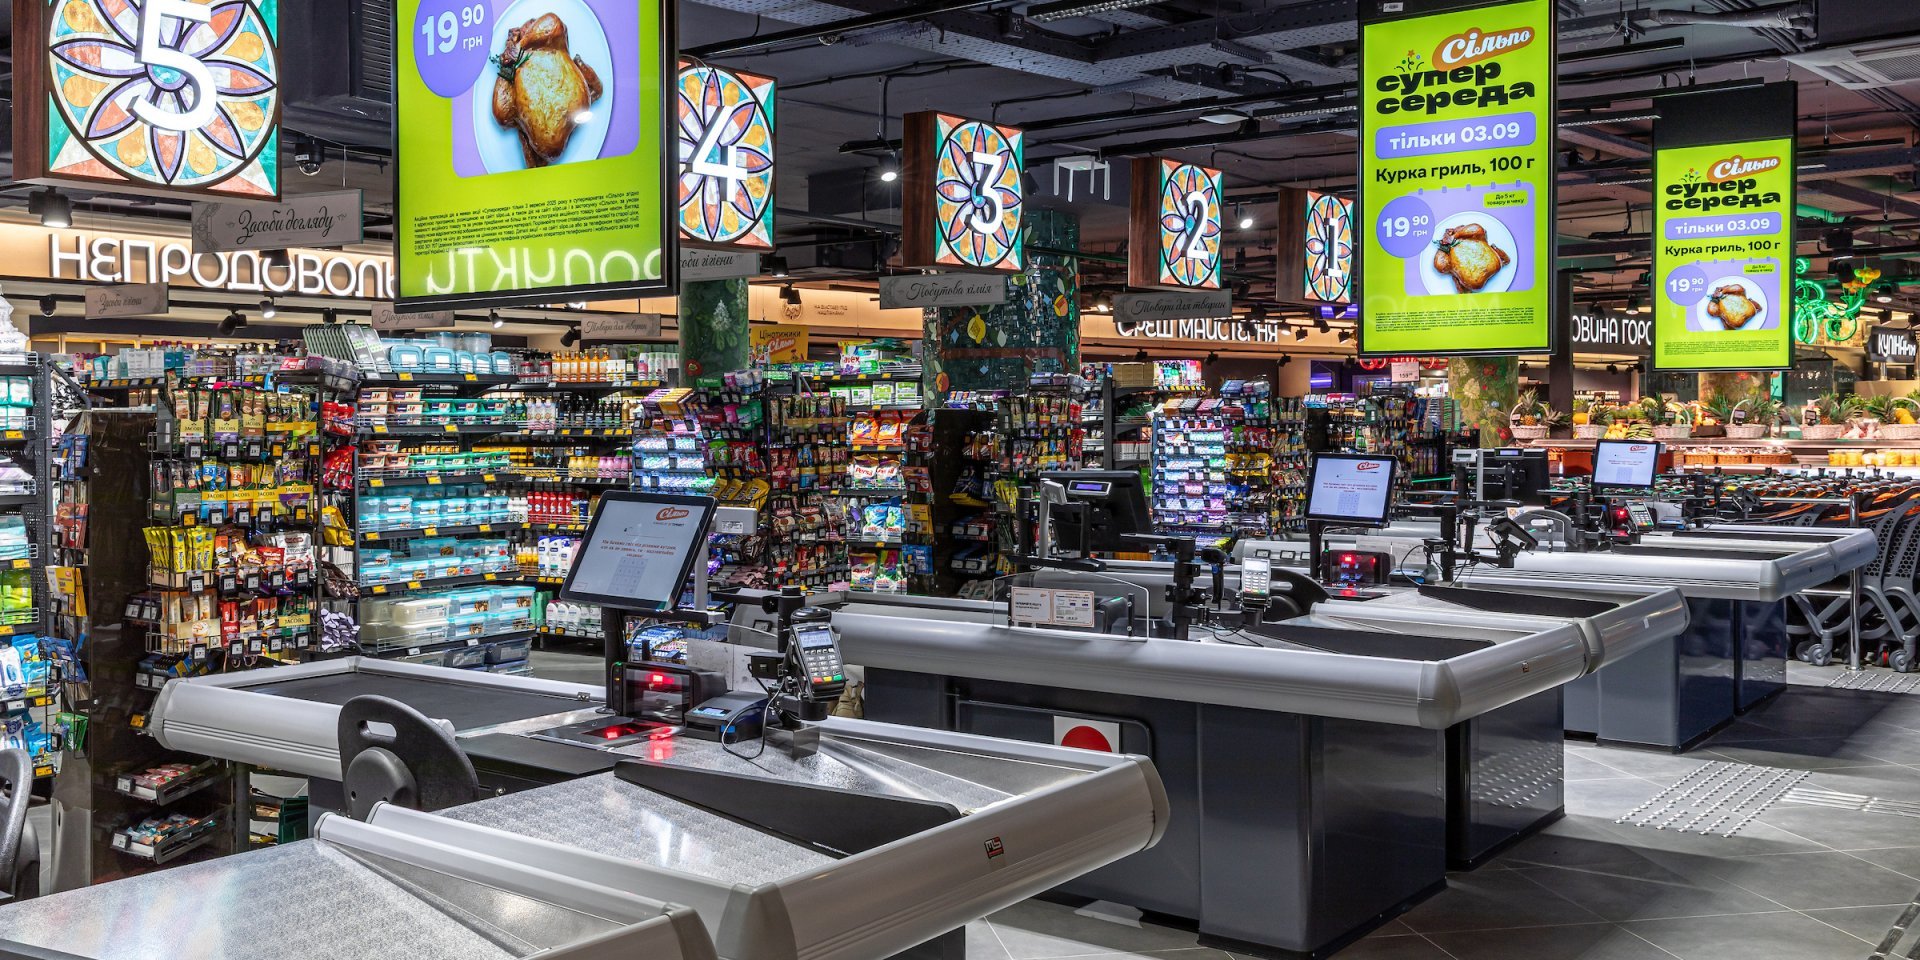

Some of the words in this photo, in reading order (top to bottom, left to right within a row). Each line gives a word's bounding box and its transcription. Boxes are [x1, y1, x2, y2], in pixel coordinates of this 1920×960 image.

[422, 11, 458, 56] 19
[462, 4, 484, 27] 90
[463, 35, 482, 51] грн
[1442, 30, 1531, 64] Сільпо
[129, 0, 216, 131] 5
[1376, 62, 1501, 95] супер
[1376, 81, 1535, 115] середа
[1390, 132, 1456, 150] тільки
[1461, 122, 1520, 143] 03.09
[691, 105, 747, 202] 4
[1376, 168, 1427, 184] Курка
[1431, 163, 1486, 179] гриль,
[1490, 156, 1522, 171] 100
[1527, 158, 1535, 169] г
[1713, 158, 1778, 179] Сільпо
[969, 151, 1003, 234] 3
[1666, 178, 1757, 198] супер
[1666, 192, 1781, 211] середа
[236, 209, 284, 245] Засоби
[285, 205, 334, 238] догляду
[1182, 191, 1208, 259] 2
[1383, 217, 1410, 238] 19
[1413, 215, 1429, 225] 90
[1413, 229, 1428, 238] грн
[1676, 222, 1724, 234] тільки
[1727, 218, 1770, 231] 03.09
[1325, 217, 1342, 277] 1
[1665, 245, 1703, 256] Курка
[1706, 243, 1745, 255] гриль,
[1748, 241, 1771, 251] 100
[702, 254, 734, 268] гігієни
[906, 280, 964, 302] Побутова
[966, 284, 992, 294] хімія
[1670, 278, 1690, 292] 19
[1131, 300, 1174, 316] Товари
[1175, 298, 1191, 311] для
